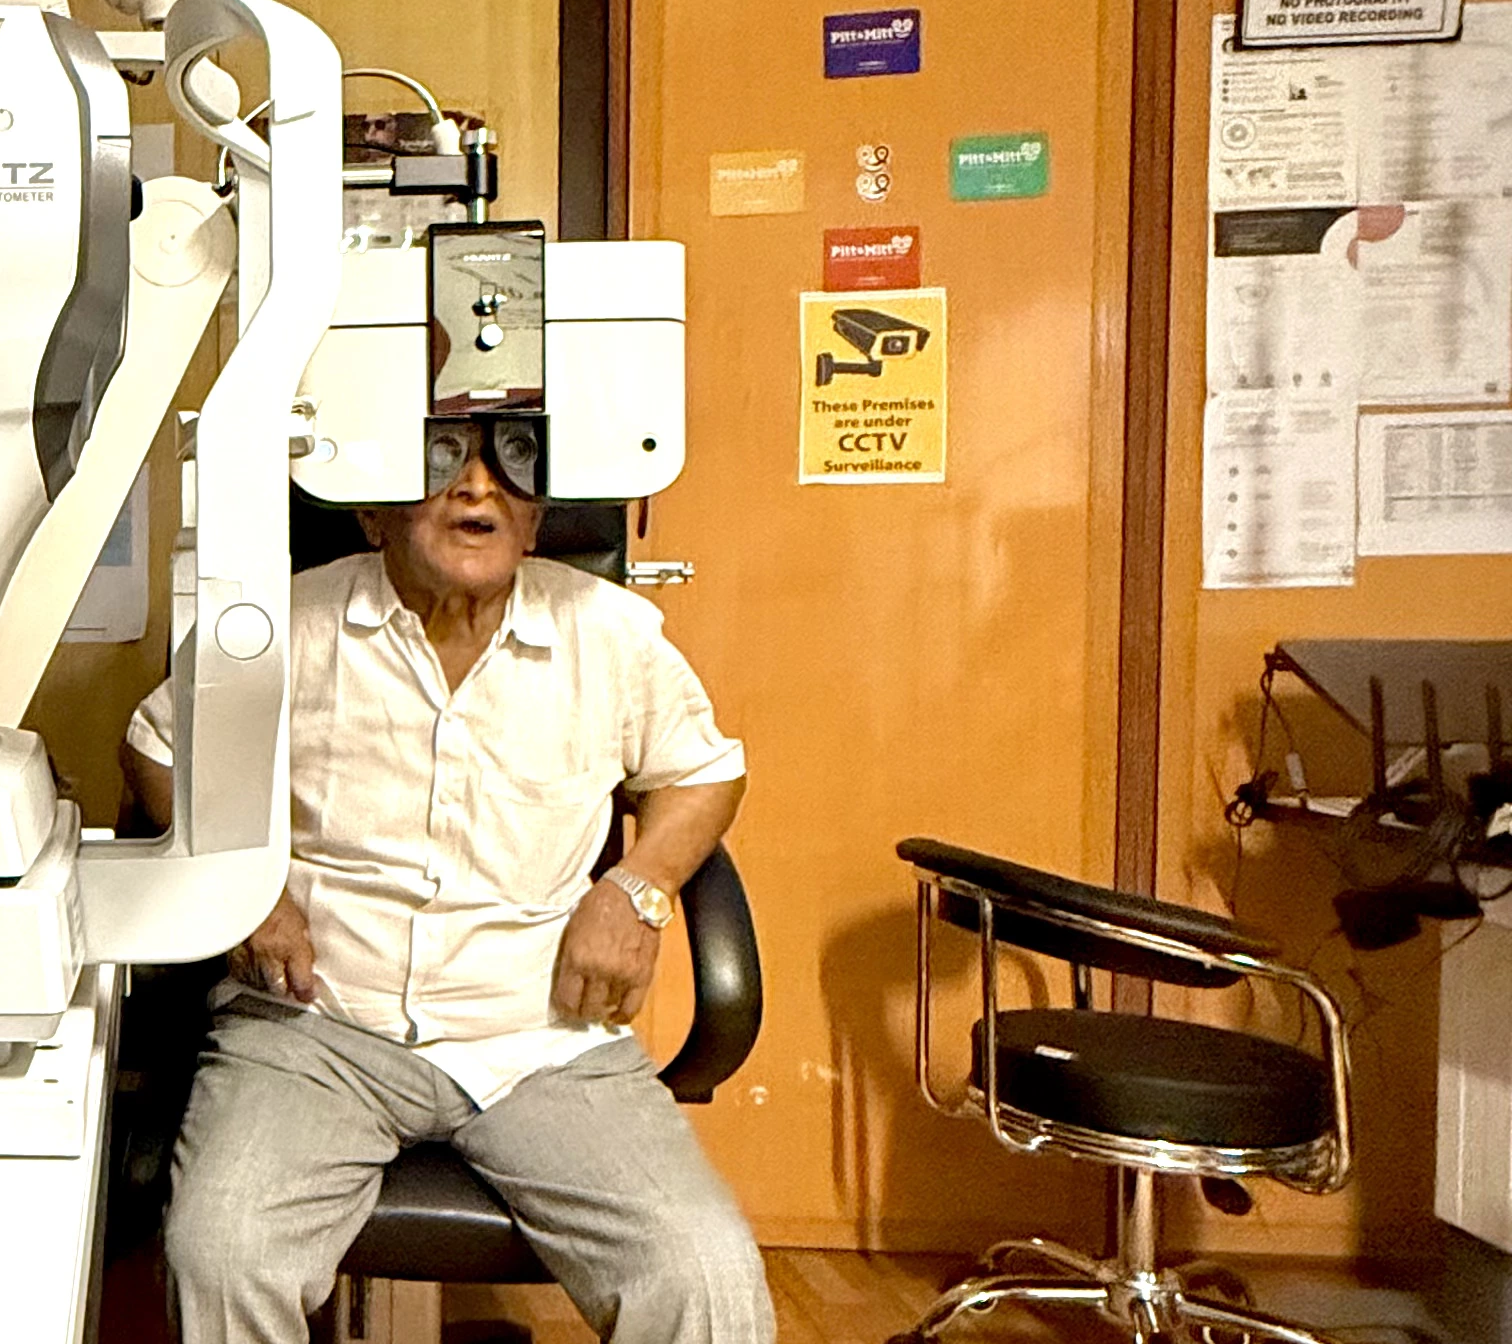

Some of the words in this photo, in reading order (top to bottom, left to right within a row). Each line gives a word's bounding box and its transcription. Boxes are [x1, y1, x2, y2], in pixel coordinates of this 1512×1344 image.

[1266, 14, 1287, 27] NO
[1292, 11, 1334, 26] VIDEO
[1338, 8, 1424, 24] RECORDING
[812, 399, 858, 413] These
[862, 398, 935, 412] Premises
[834, 417, 860, 429] are
[863, 415, 913, 428] under
[838, 432, 908, 453] CCTV
[824, 458, 923, 473] Surveillance
